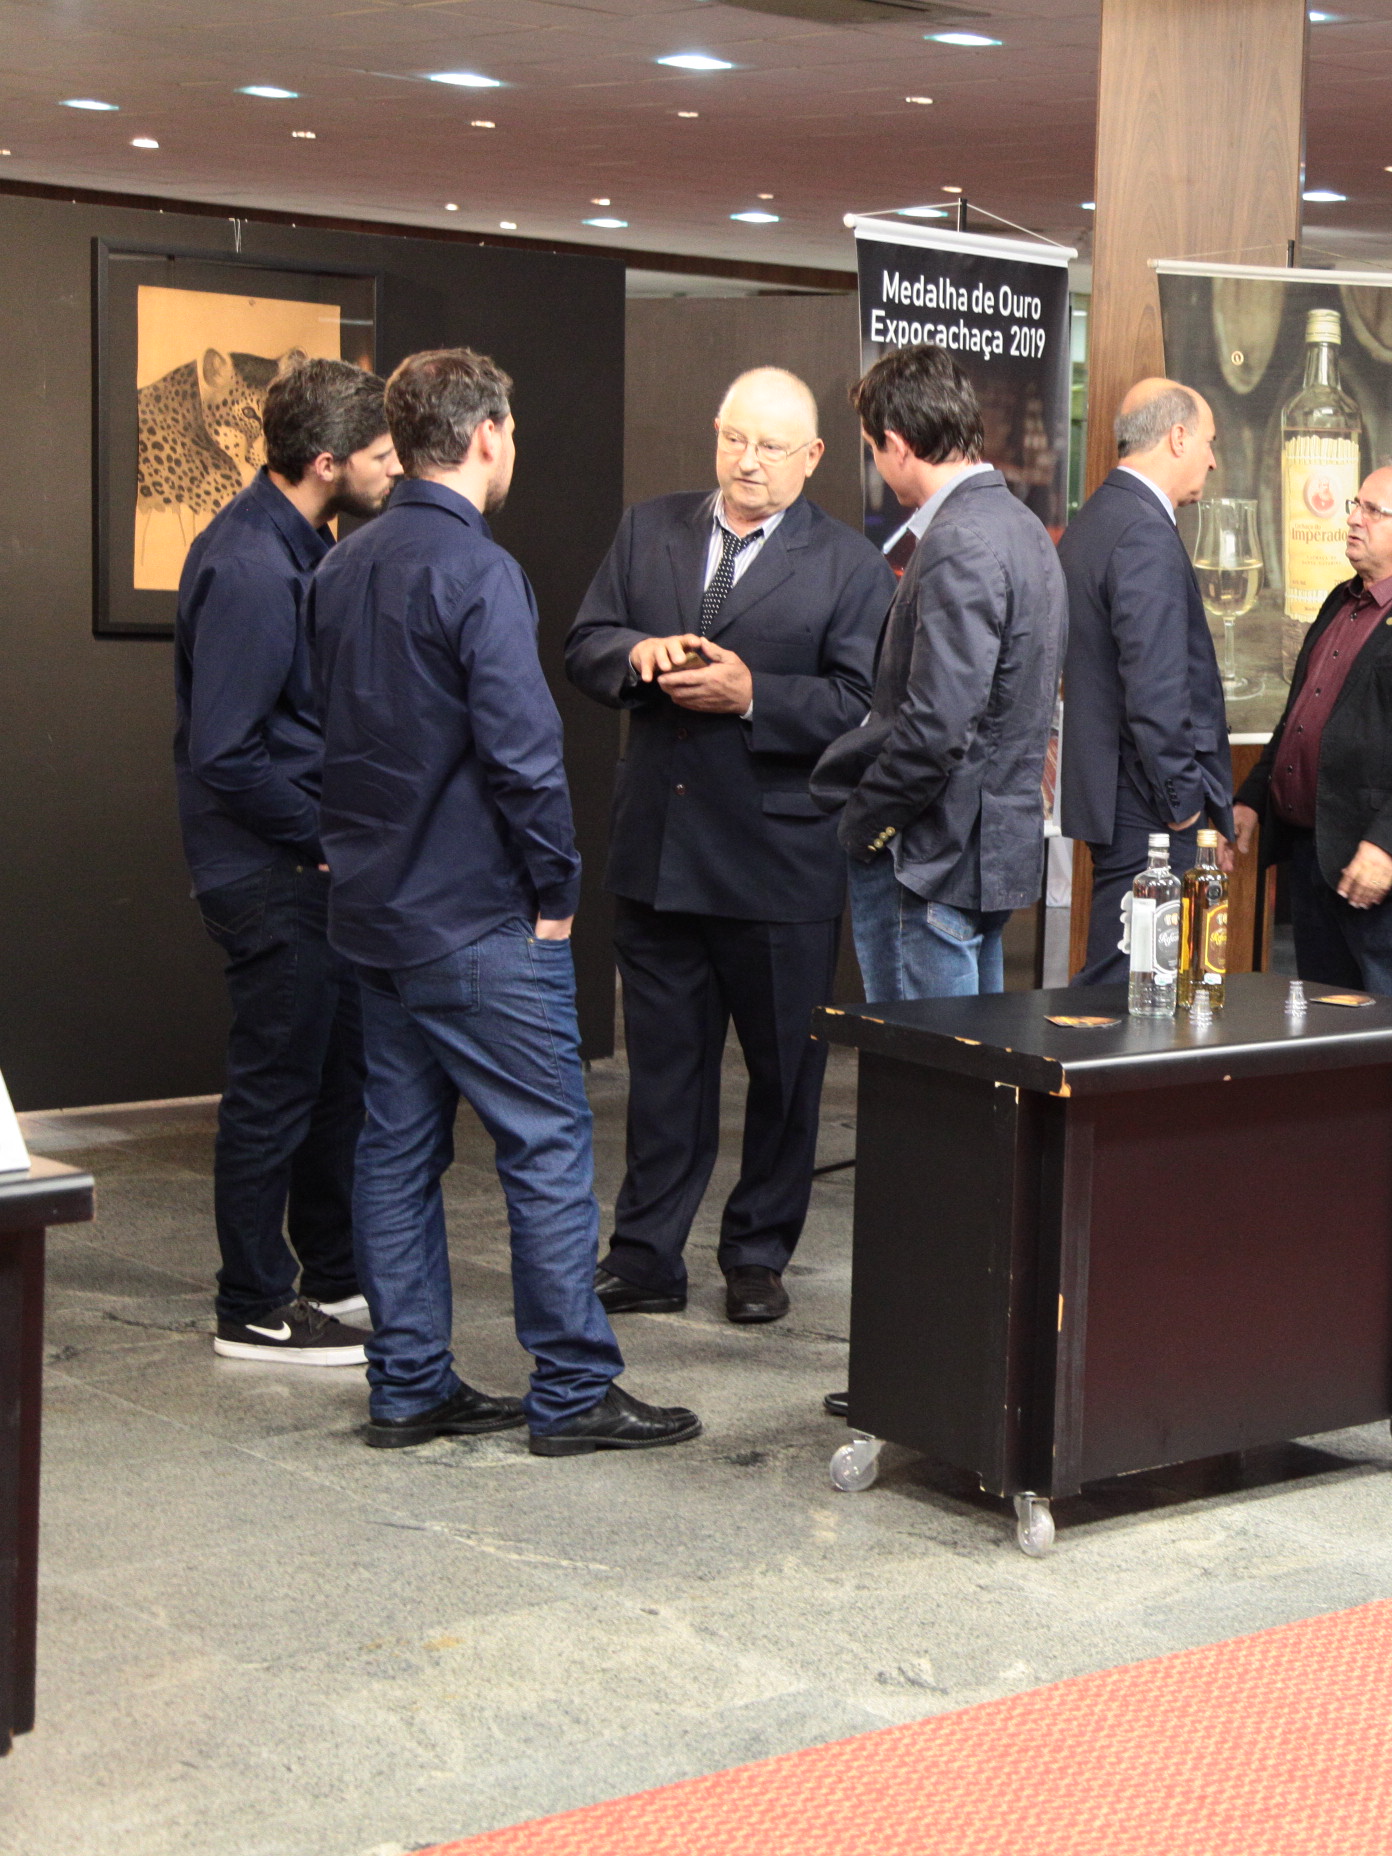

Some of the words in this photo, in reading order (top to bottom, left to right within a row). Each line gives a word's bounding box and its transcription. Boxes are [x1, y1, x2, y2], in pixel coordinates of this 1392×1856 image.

[882, 270, 968, 312] Medalha
[972, 282, 995, 314] de
[998, 285, 1042, 320] Ouro
[870, 308, 1004, 361] Expocachaça
[1009, 325, 1046, 359] 2019
[1291, 527, 1348, 545] Imperado
